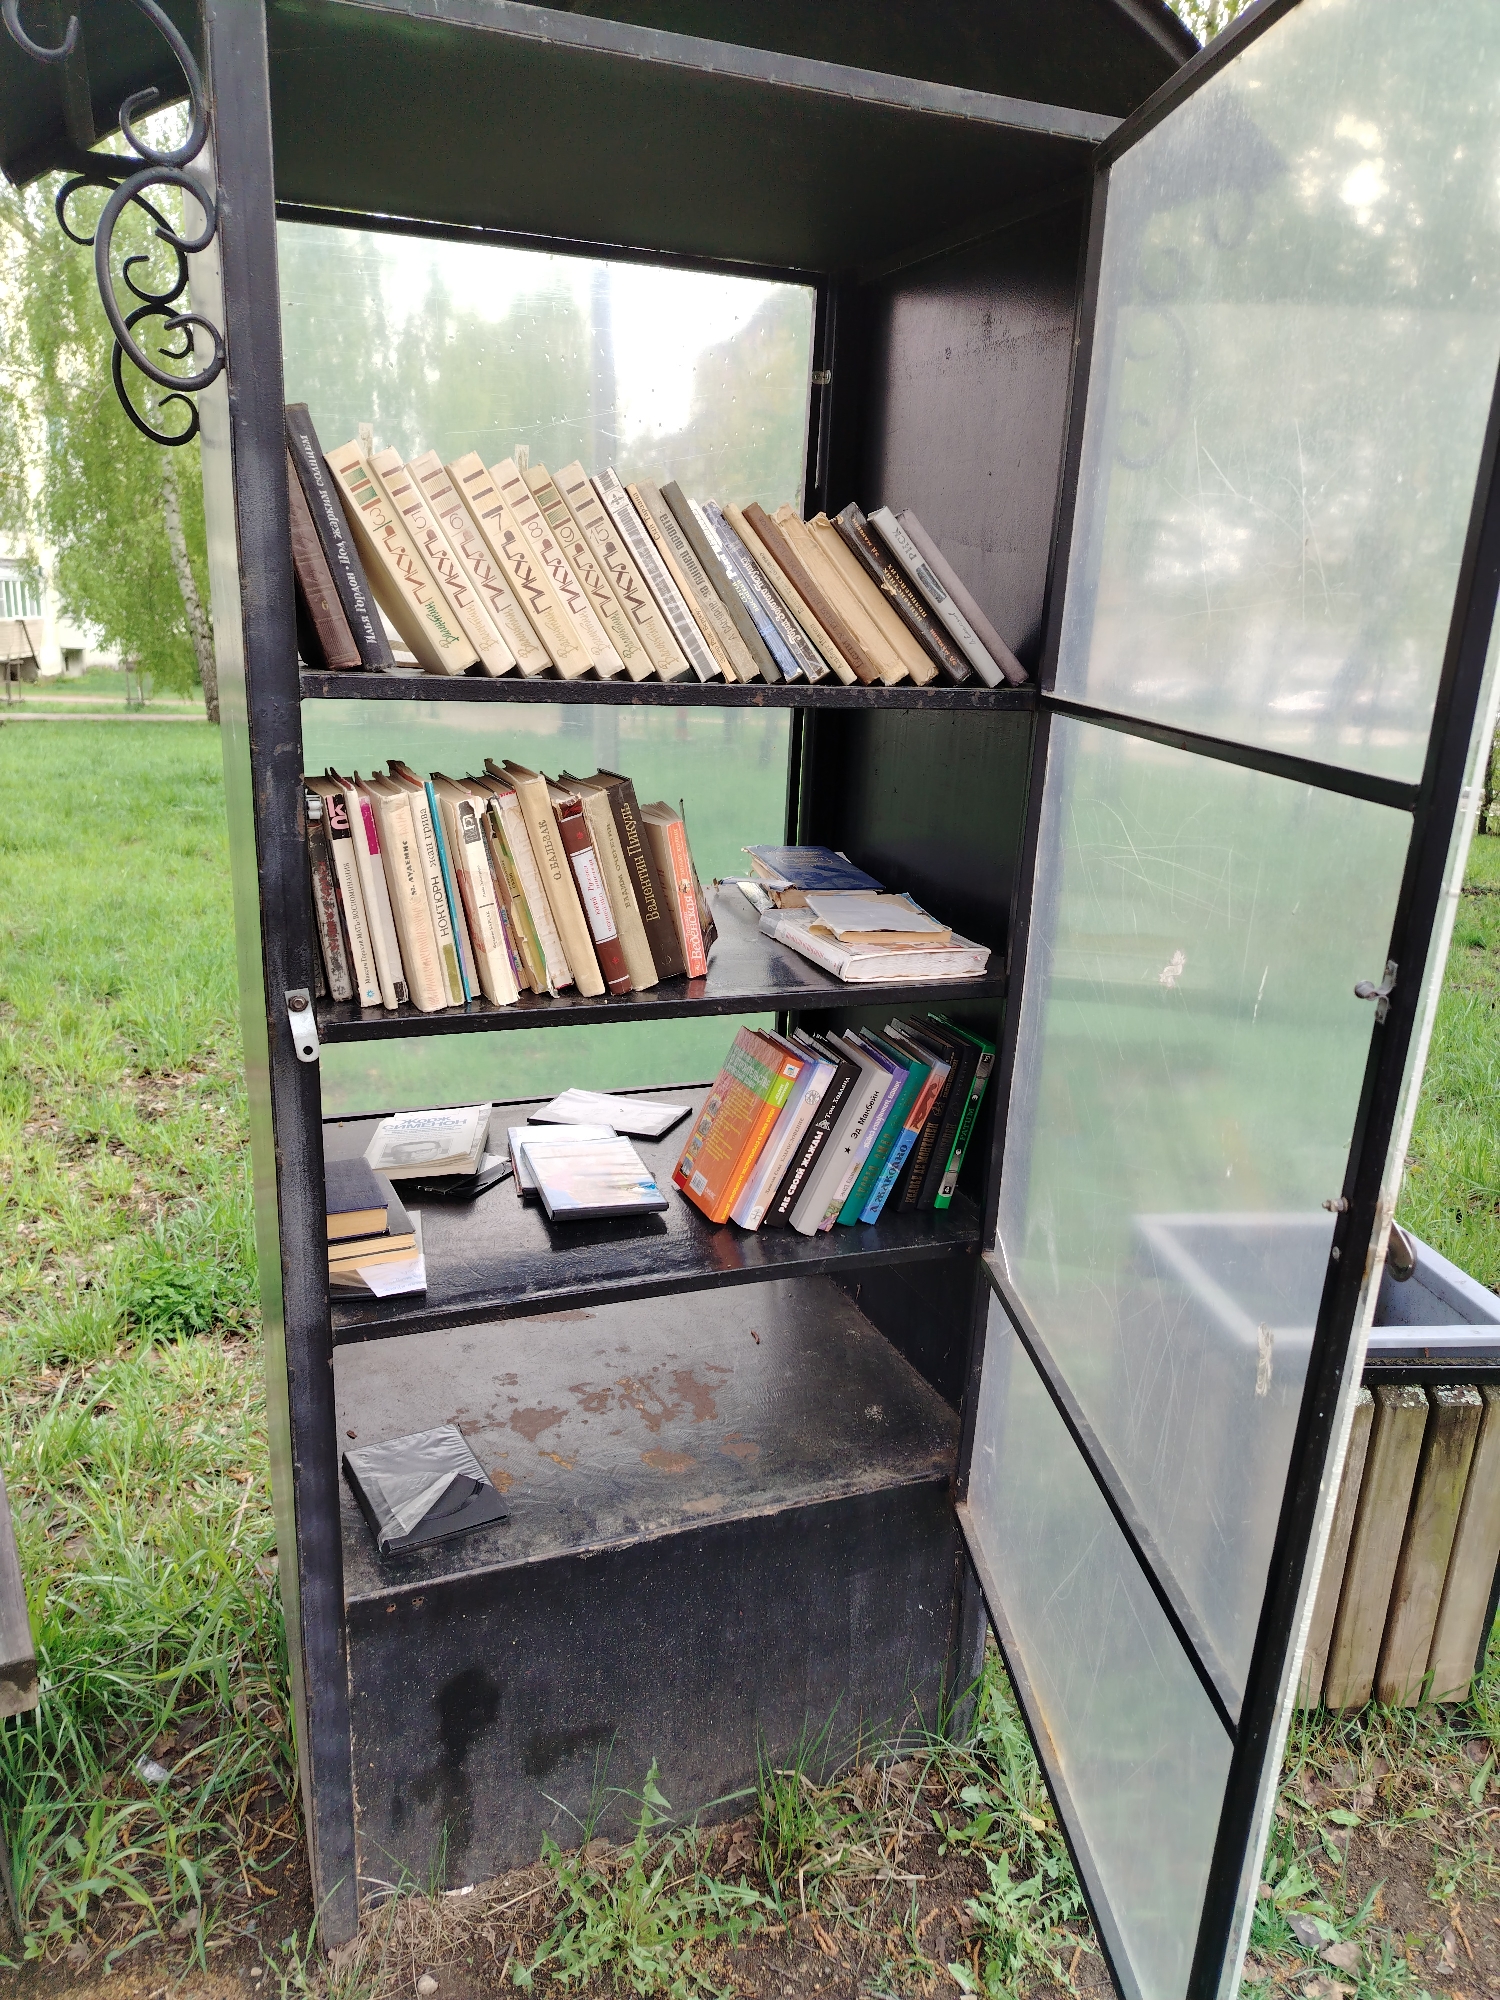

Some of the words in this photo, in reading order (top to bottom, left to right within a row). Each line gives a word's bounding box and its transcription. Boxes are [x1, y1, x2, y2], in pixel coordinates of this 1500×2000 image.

[319, 490, 342, 539] жарким
[367, 506, 386, 527] 3
[410, 509, 428, 529] 5
[447, 512, 464, 530] 6
[490, 512, 505, 532] 7
[526, 520, 544, 539] 8
[558, 524, 575, 544] 9
[588, 522, 610, 544] 15
[335, 540, 350, 564] Под
[345, 571, 366, 612] Гордон
[361, 615, 376, 643] Илья
[616, 801, 643, 856] Пикуль
[538, 819, 559, 869] БАЛЬЗАК
[617, 873, 631, 908] ВАДИМ
[633, 855, 660, 921] Валентин
[430, 875, 449, 937] НОКТЮРН
[677, 895, 707, 958] Веденская
[401, 1115, 454, 1125] ЖОРЖ
[824, 1104, 835, 1118] Том
[959, 1107, 974, 1140] FATUM
[381, 1118, 468, 1131] СИМЕНОН
[849, 1126, 862, 1140] Эд
[916, 1121, 938, 1162] МОНТЕПЕН
[777, 1195, 790, 1213] РАБ
[786, 1167, 805, 1195] СВОЕЙ
[800, 1130, 823, 1167] ЖАЖДЫ
